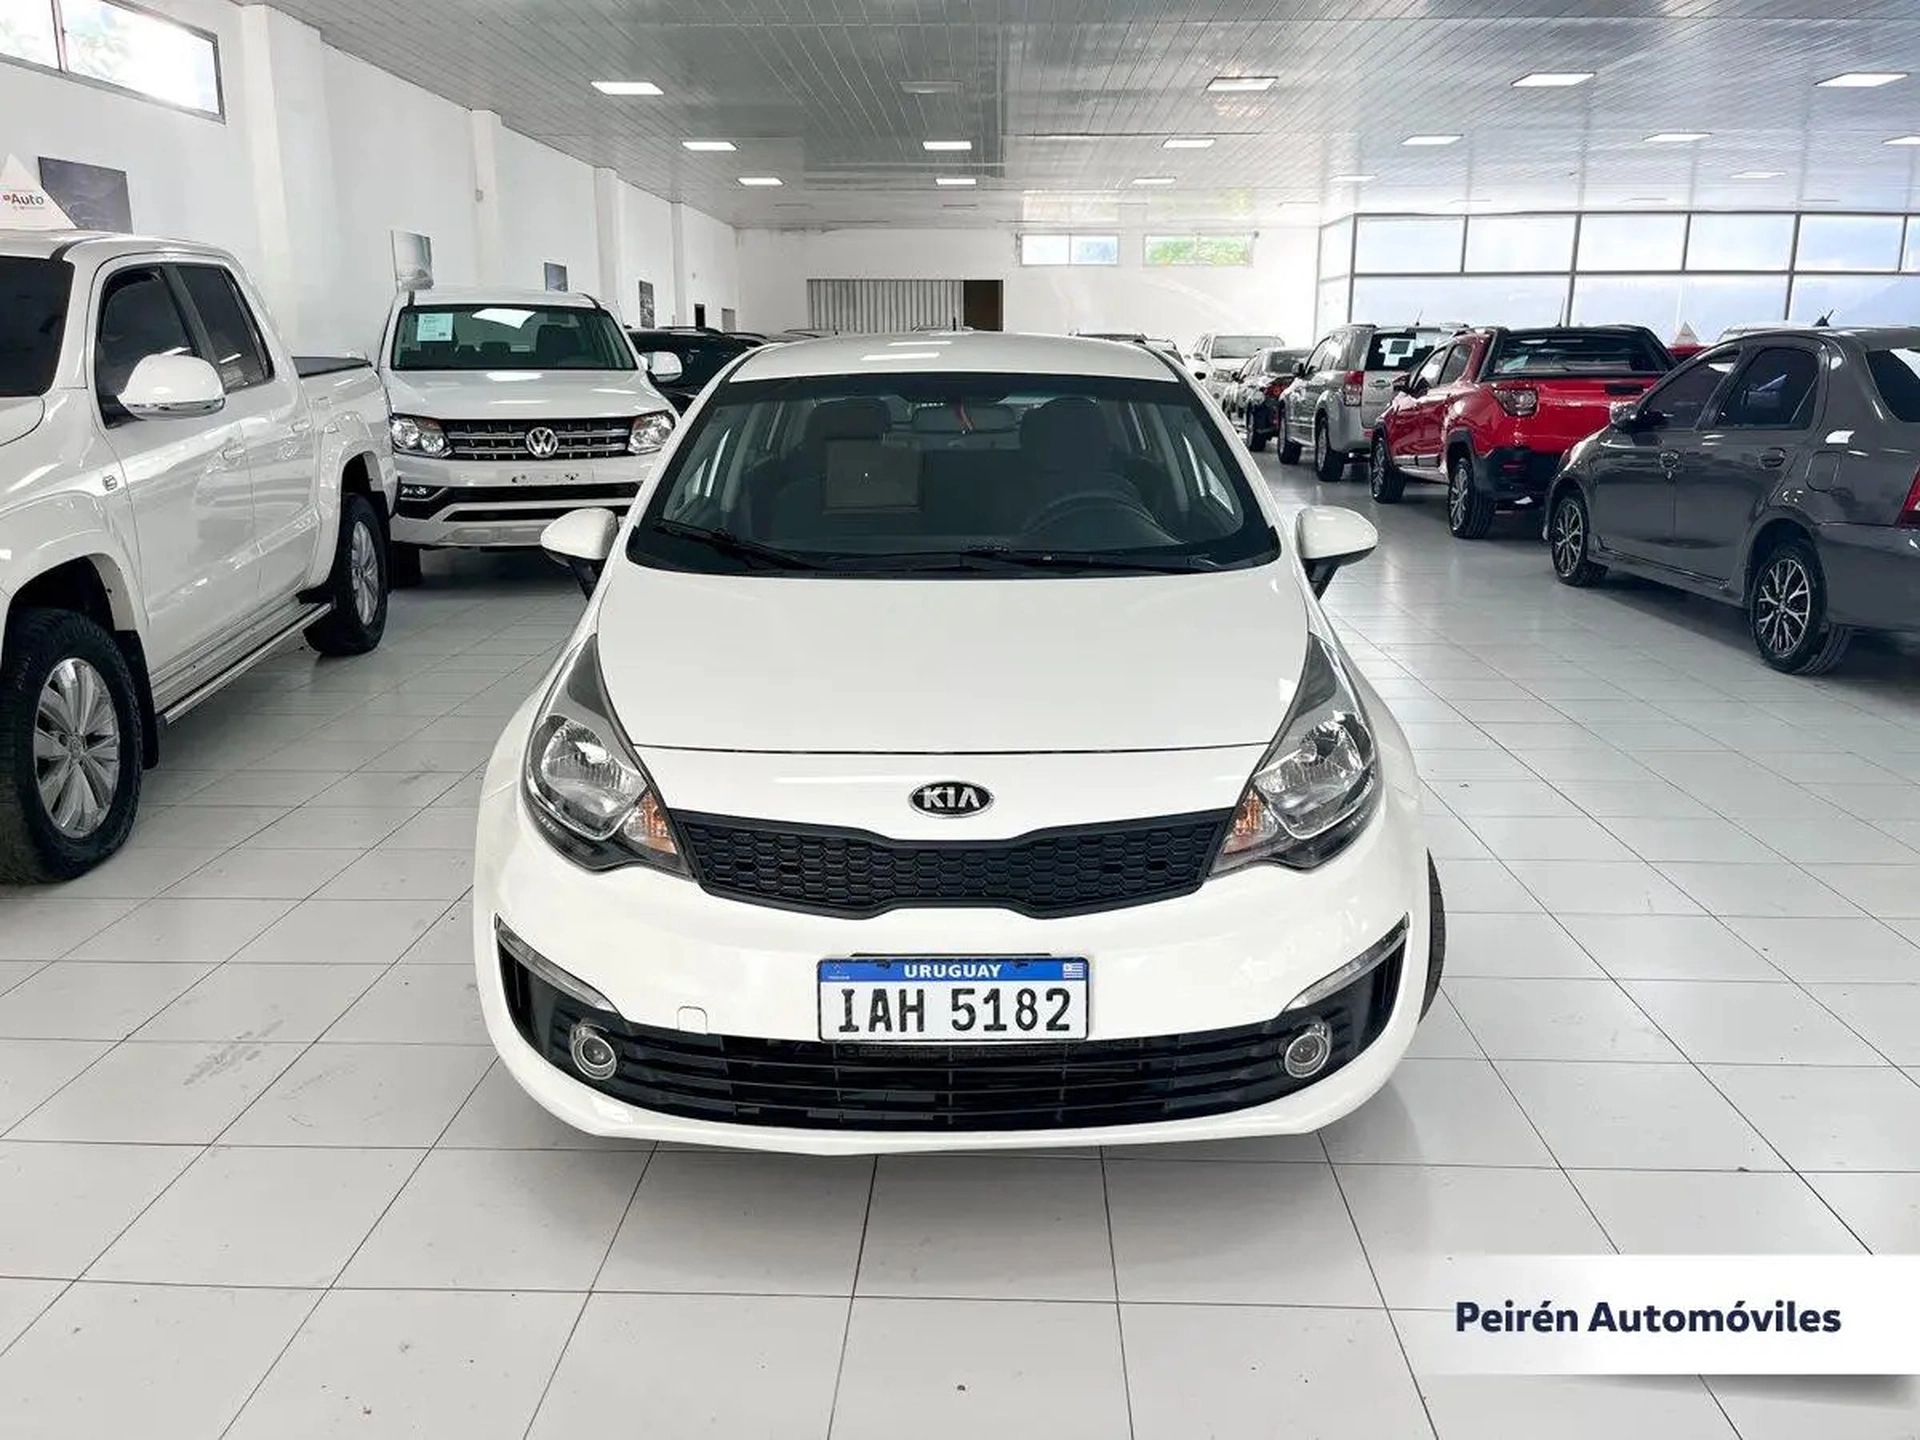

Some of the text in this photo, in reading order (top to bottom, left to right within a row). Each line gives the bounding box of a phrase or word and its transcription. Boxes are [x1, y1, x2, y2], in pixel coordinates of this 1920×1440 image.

[923, 786, 980, 808] KIA
[904, 963, 1002, 979] URUGUAY
[839, 988, 1071, 1032] IAH 5182
